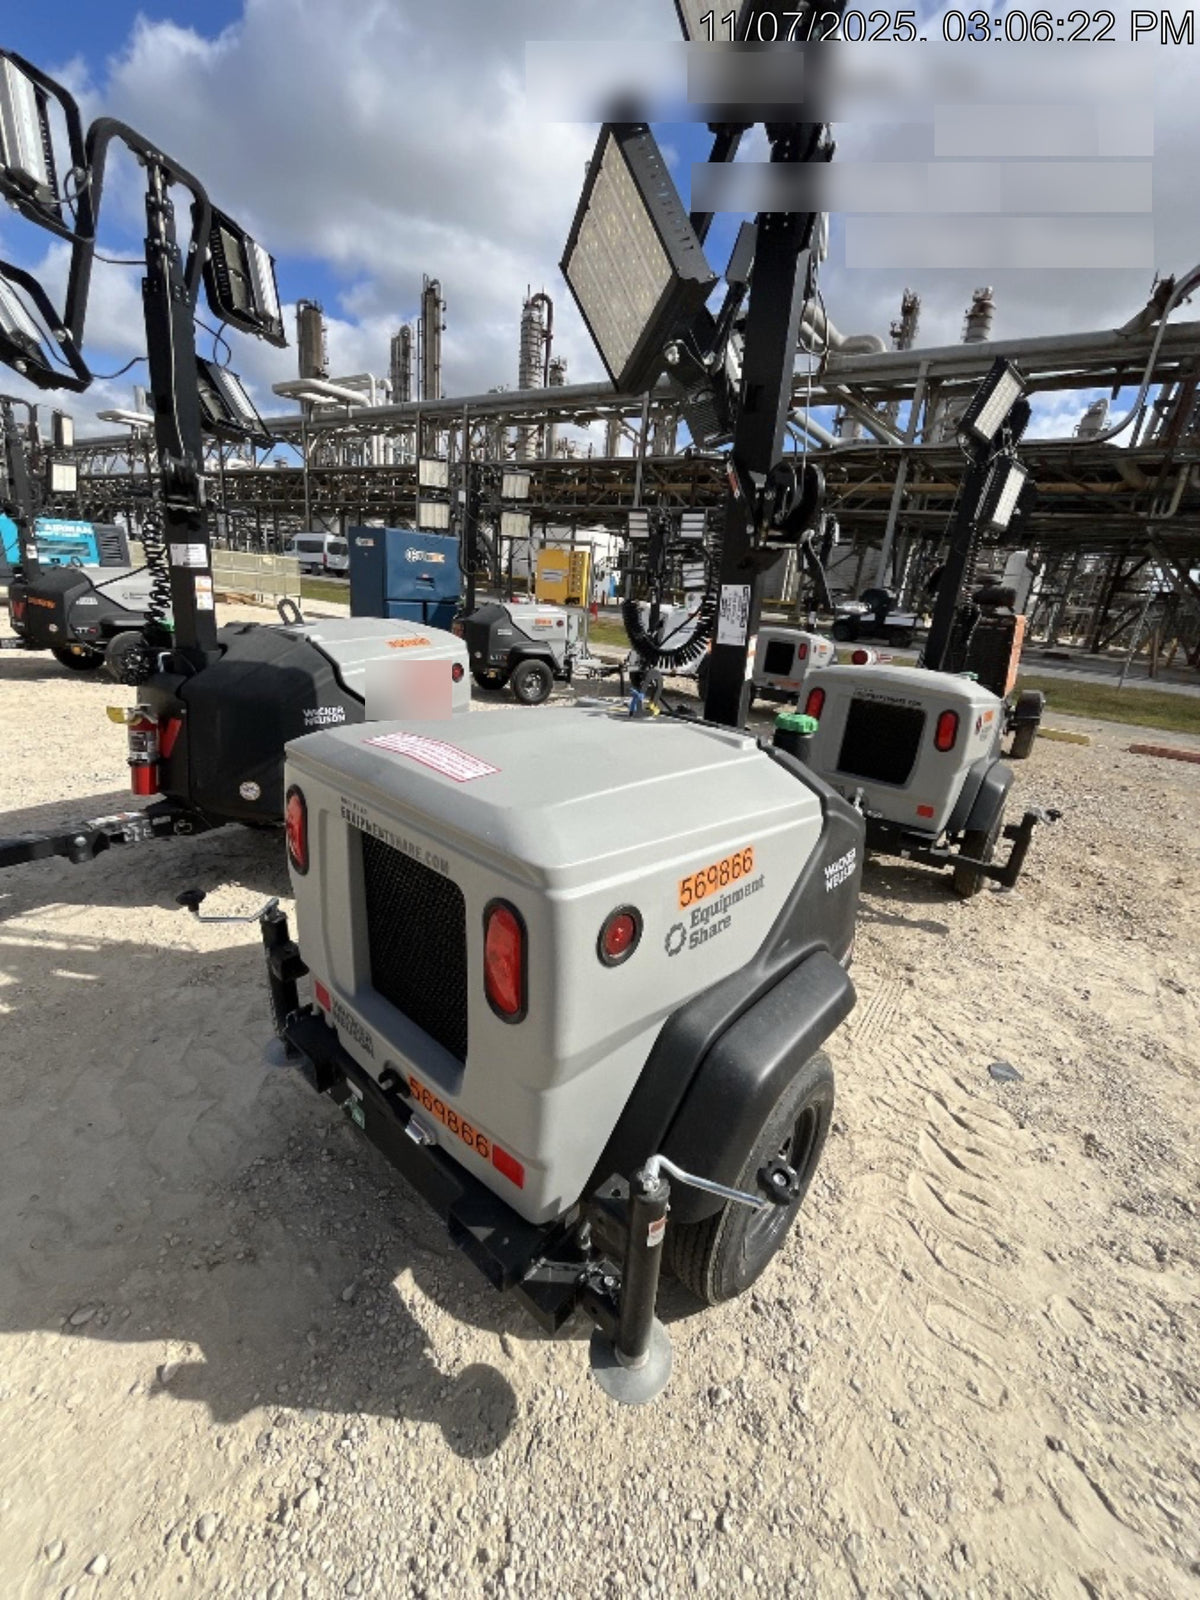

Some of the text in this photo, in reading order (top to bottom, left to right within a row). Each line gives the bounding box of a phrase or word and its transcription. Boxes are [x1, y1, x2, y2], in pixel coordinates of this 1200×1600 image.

[302, 705, 345, 717] WACKER
[304, 713, 346, 727] NEUSON
[679, 846, 754, 908] 569866
[690, 873, 765, 928] Equipment
[688, 914, 732, 950] Share
[408, 1077, 490, 1159] 569866
